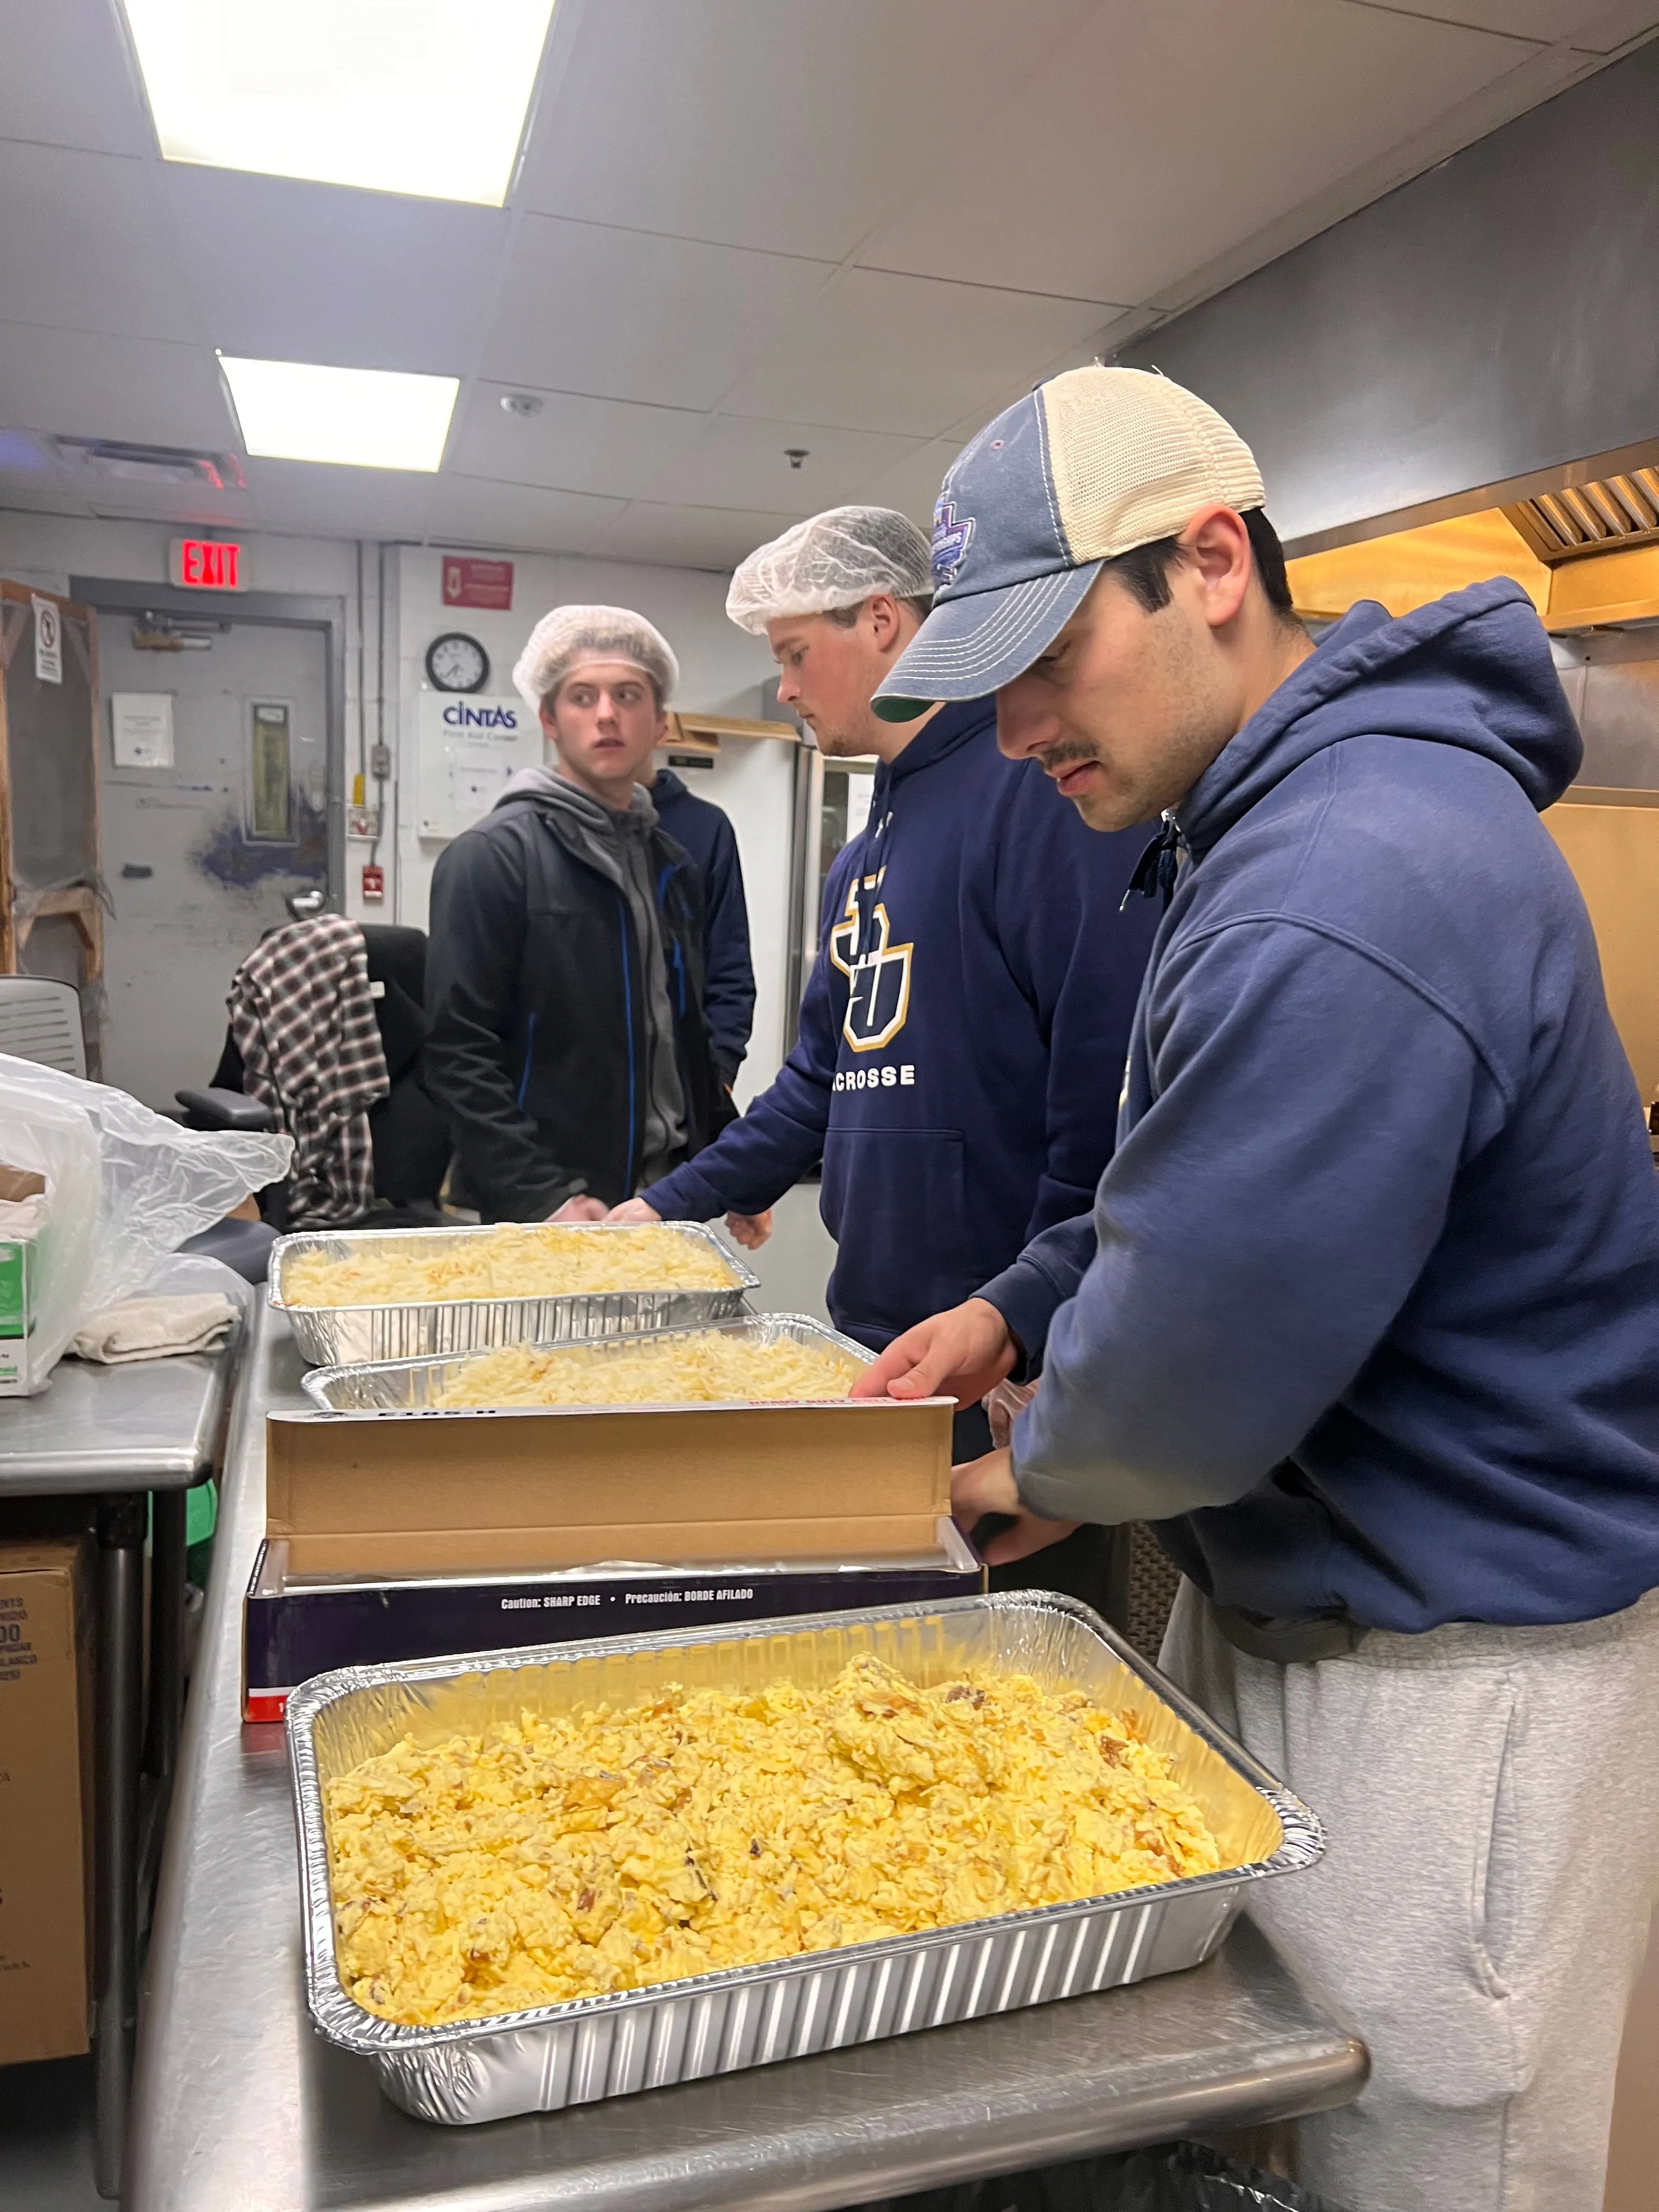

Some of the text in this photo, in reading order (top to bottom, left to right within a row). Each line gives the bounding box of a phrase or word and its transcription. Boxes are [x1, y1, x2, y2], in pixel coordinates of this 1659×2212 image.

[182, 539, 240, 589] EXIT
[443, 701, 517, 729] CINTAS
[501, 1589, 754, 1609] Caution: SHARP EDGE Precaución: BORDE AFILADO
